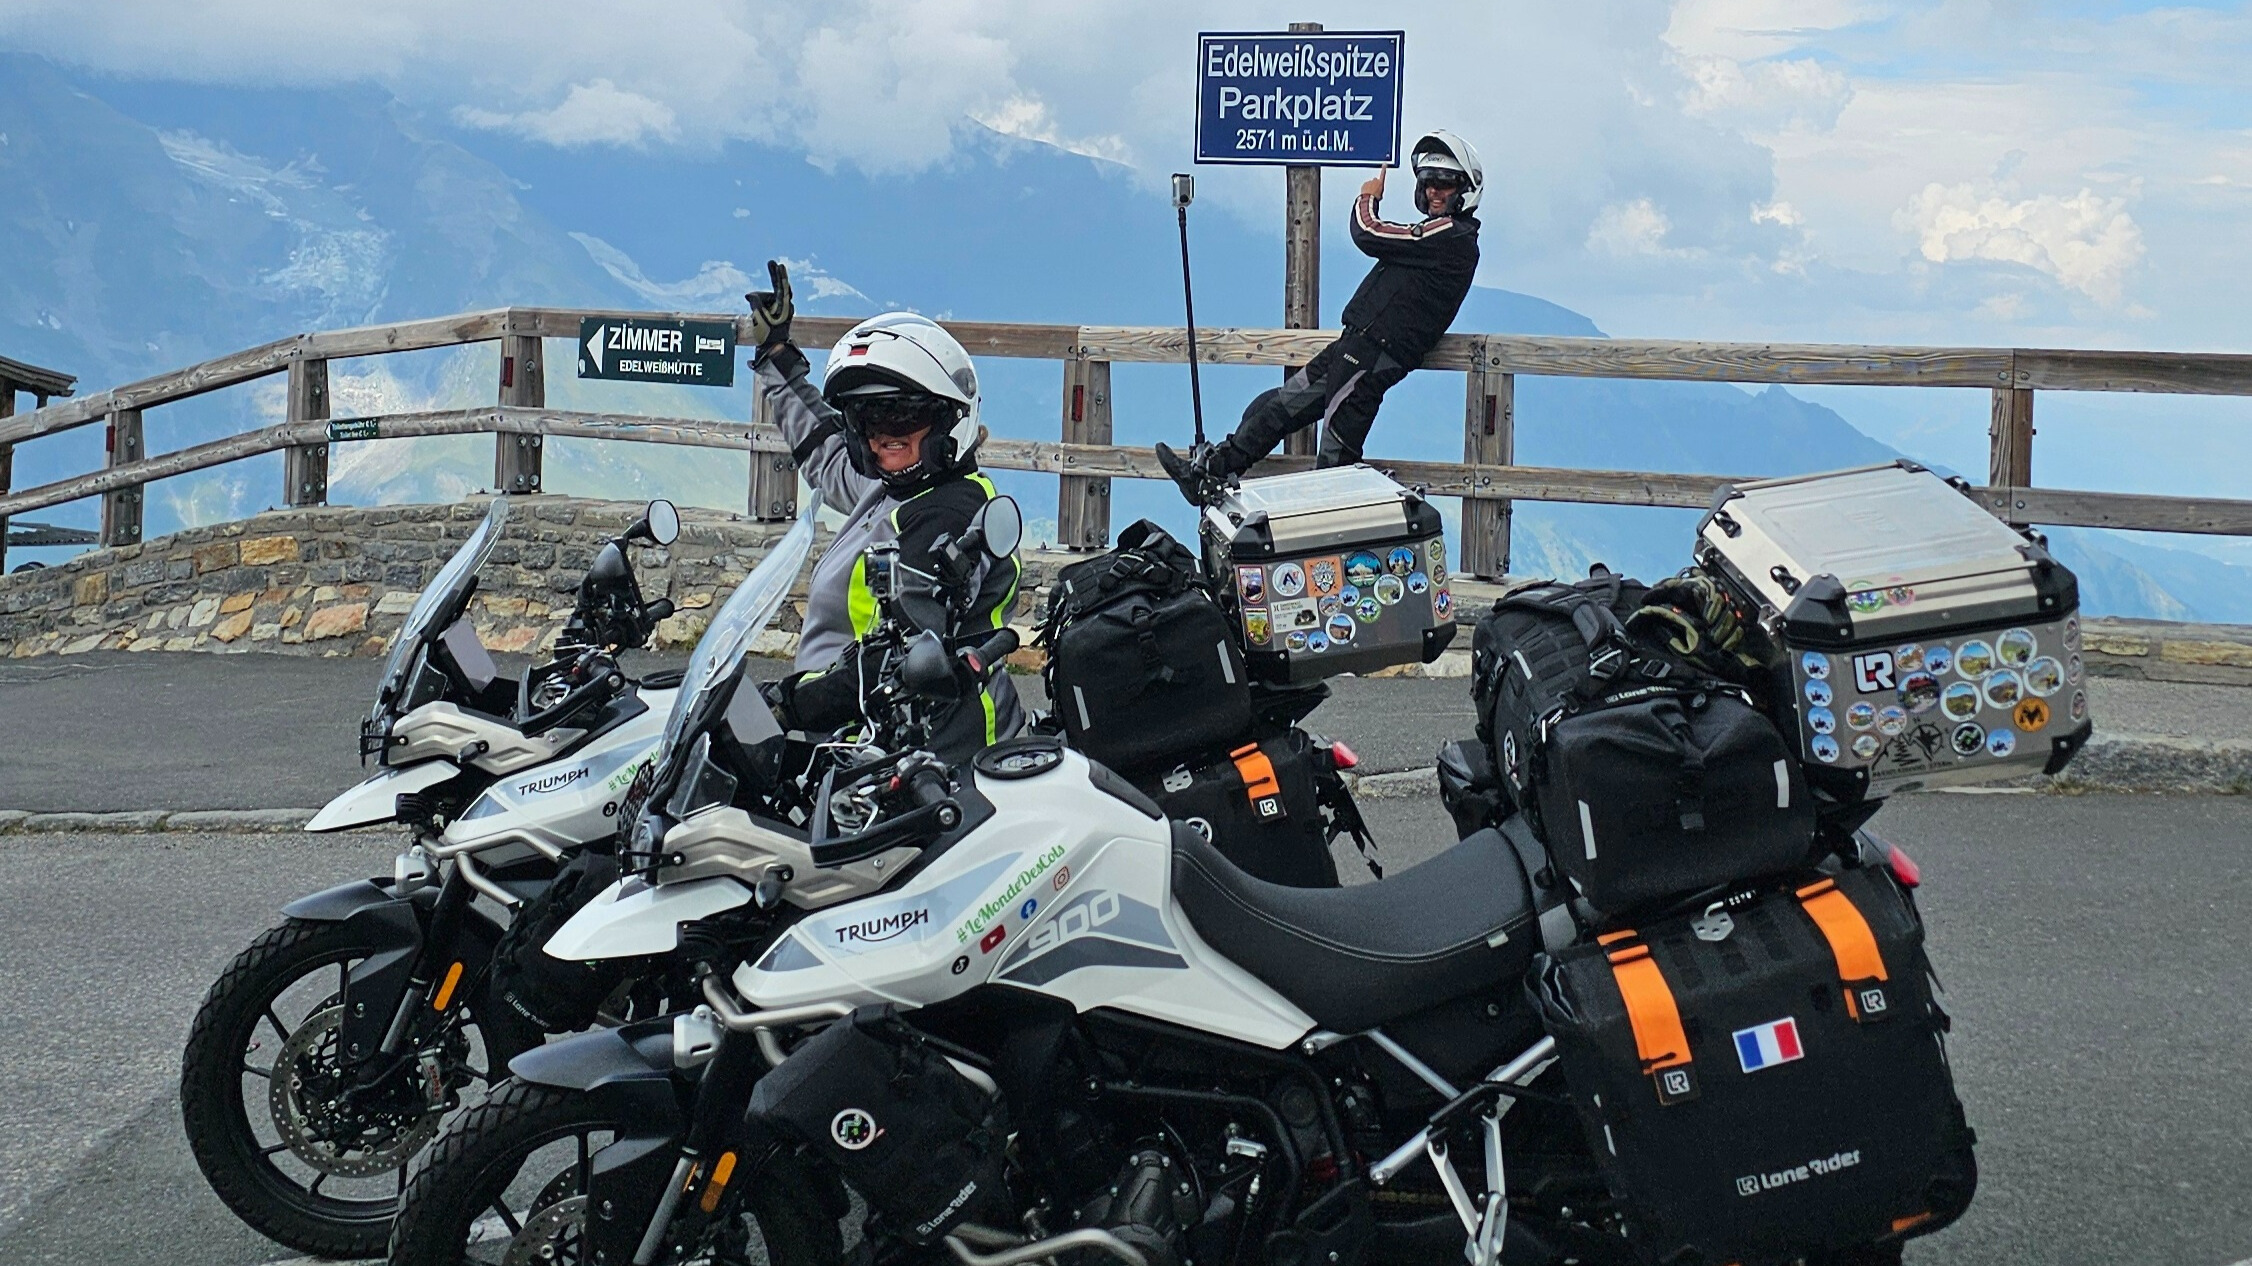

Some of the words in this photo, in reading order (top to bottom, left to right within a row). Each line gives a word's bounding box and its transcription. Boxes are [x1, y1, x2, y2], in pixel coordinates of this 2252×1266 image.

[1207, 43, 1390, 86] Edelweißspitze
[1219, 86, 1373, 127] Parkplatz
[1235, 128, 1275, 150] 2571
[1281, 134, 1297, 150] m
[518, 767, 589, 796] TRIUMPH
[956, 844, 1066, 943] #LeMondeDesCols
[835, 908, 929, 943] TRIUMPH
